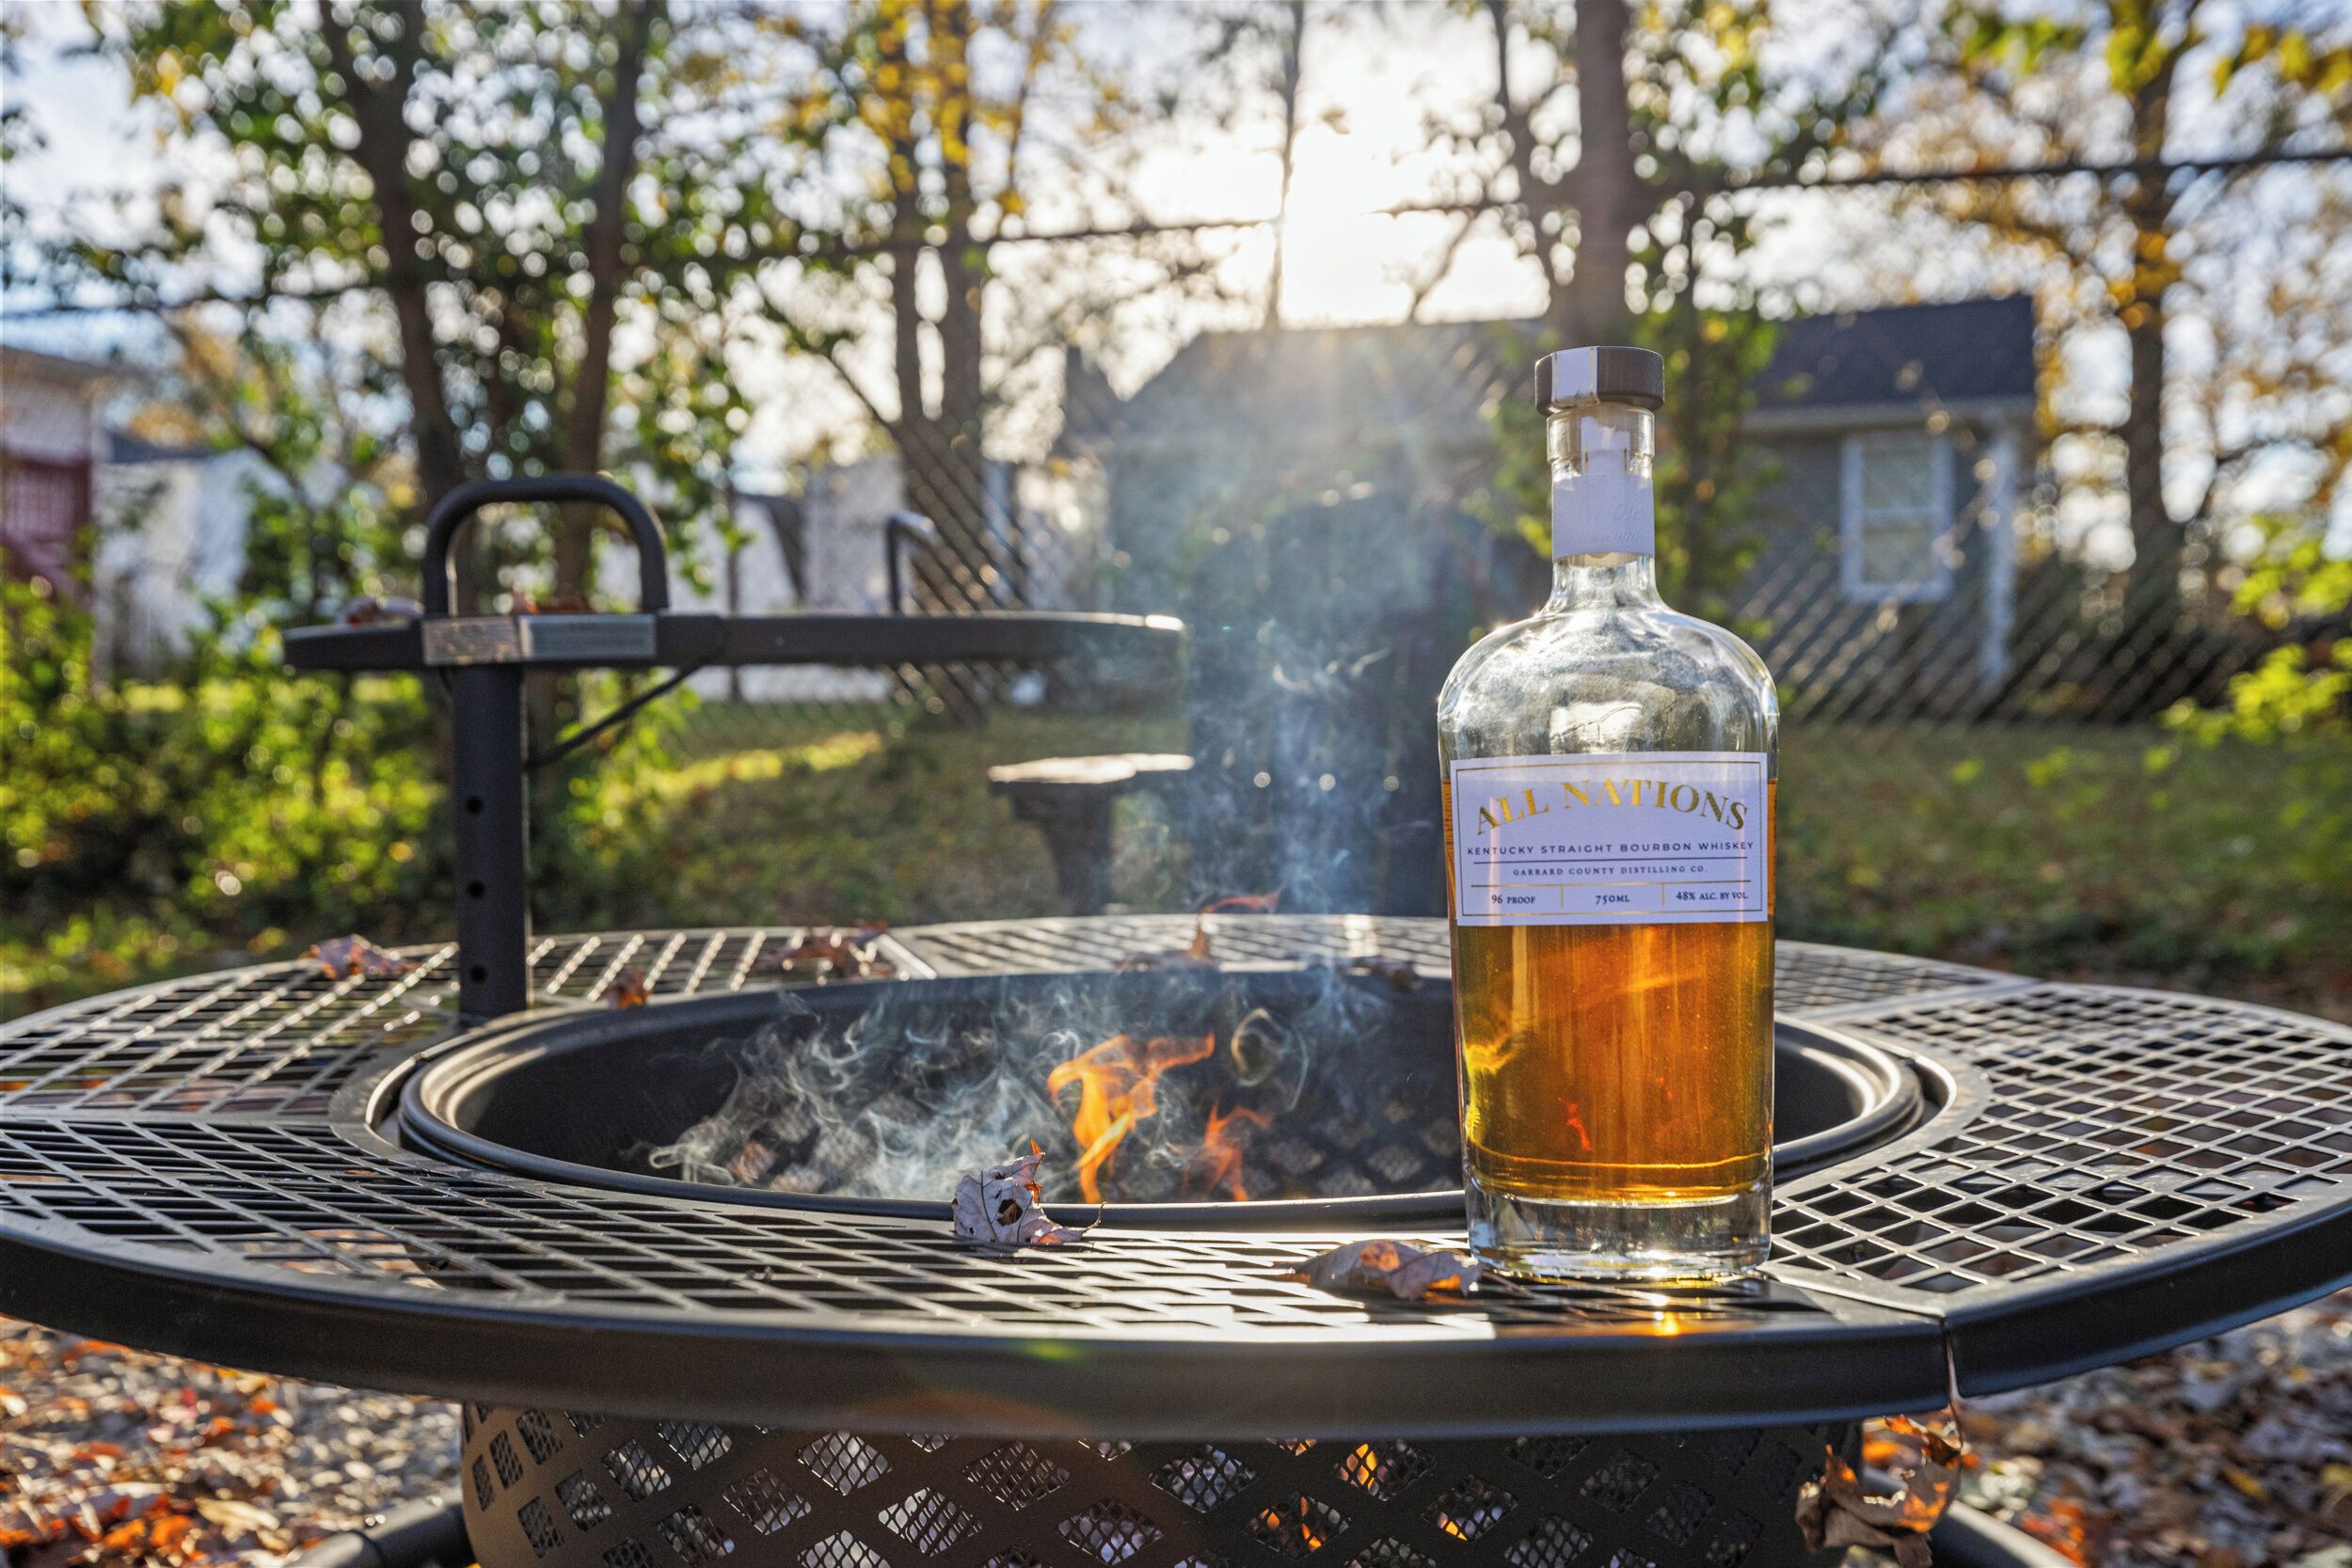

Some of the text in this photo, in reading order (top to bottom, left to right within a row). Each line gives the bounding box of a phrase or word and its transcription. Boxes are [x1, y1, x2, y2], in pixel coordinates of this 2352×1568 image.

[1477, 778, 1748, 836] ALL NATIONS
[1468, 842, 1754, 855] KENTUCKY STRAIGHT BOURBON WHISKEY
[1621, 865, 1686, 874] DISTILLING
[1491, 895, 1502, 904] 96
[1595, 895, 1630, 905] 750ML
[1676, 891, 1695, 900] 48%
